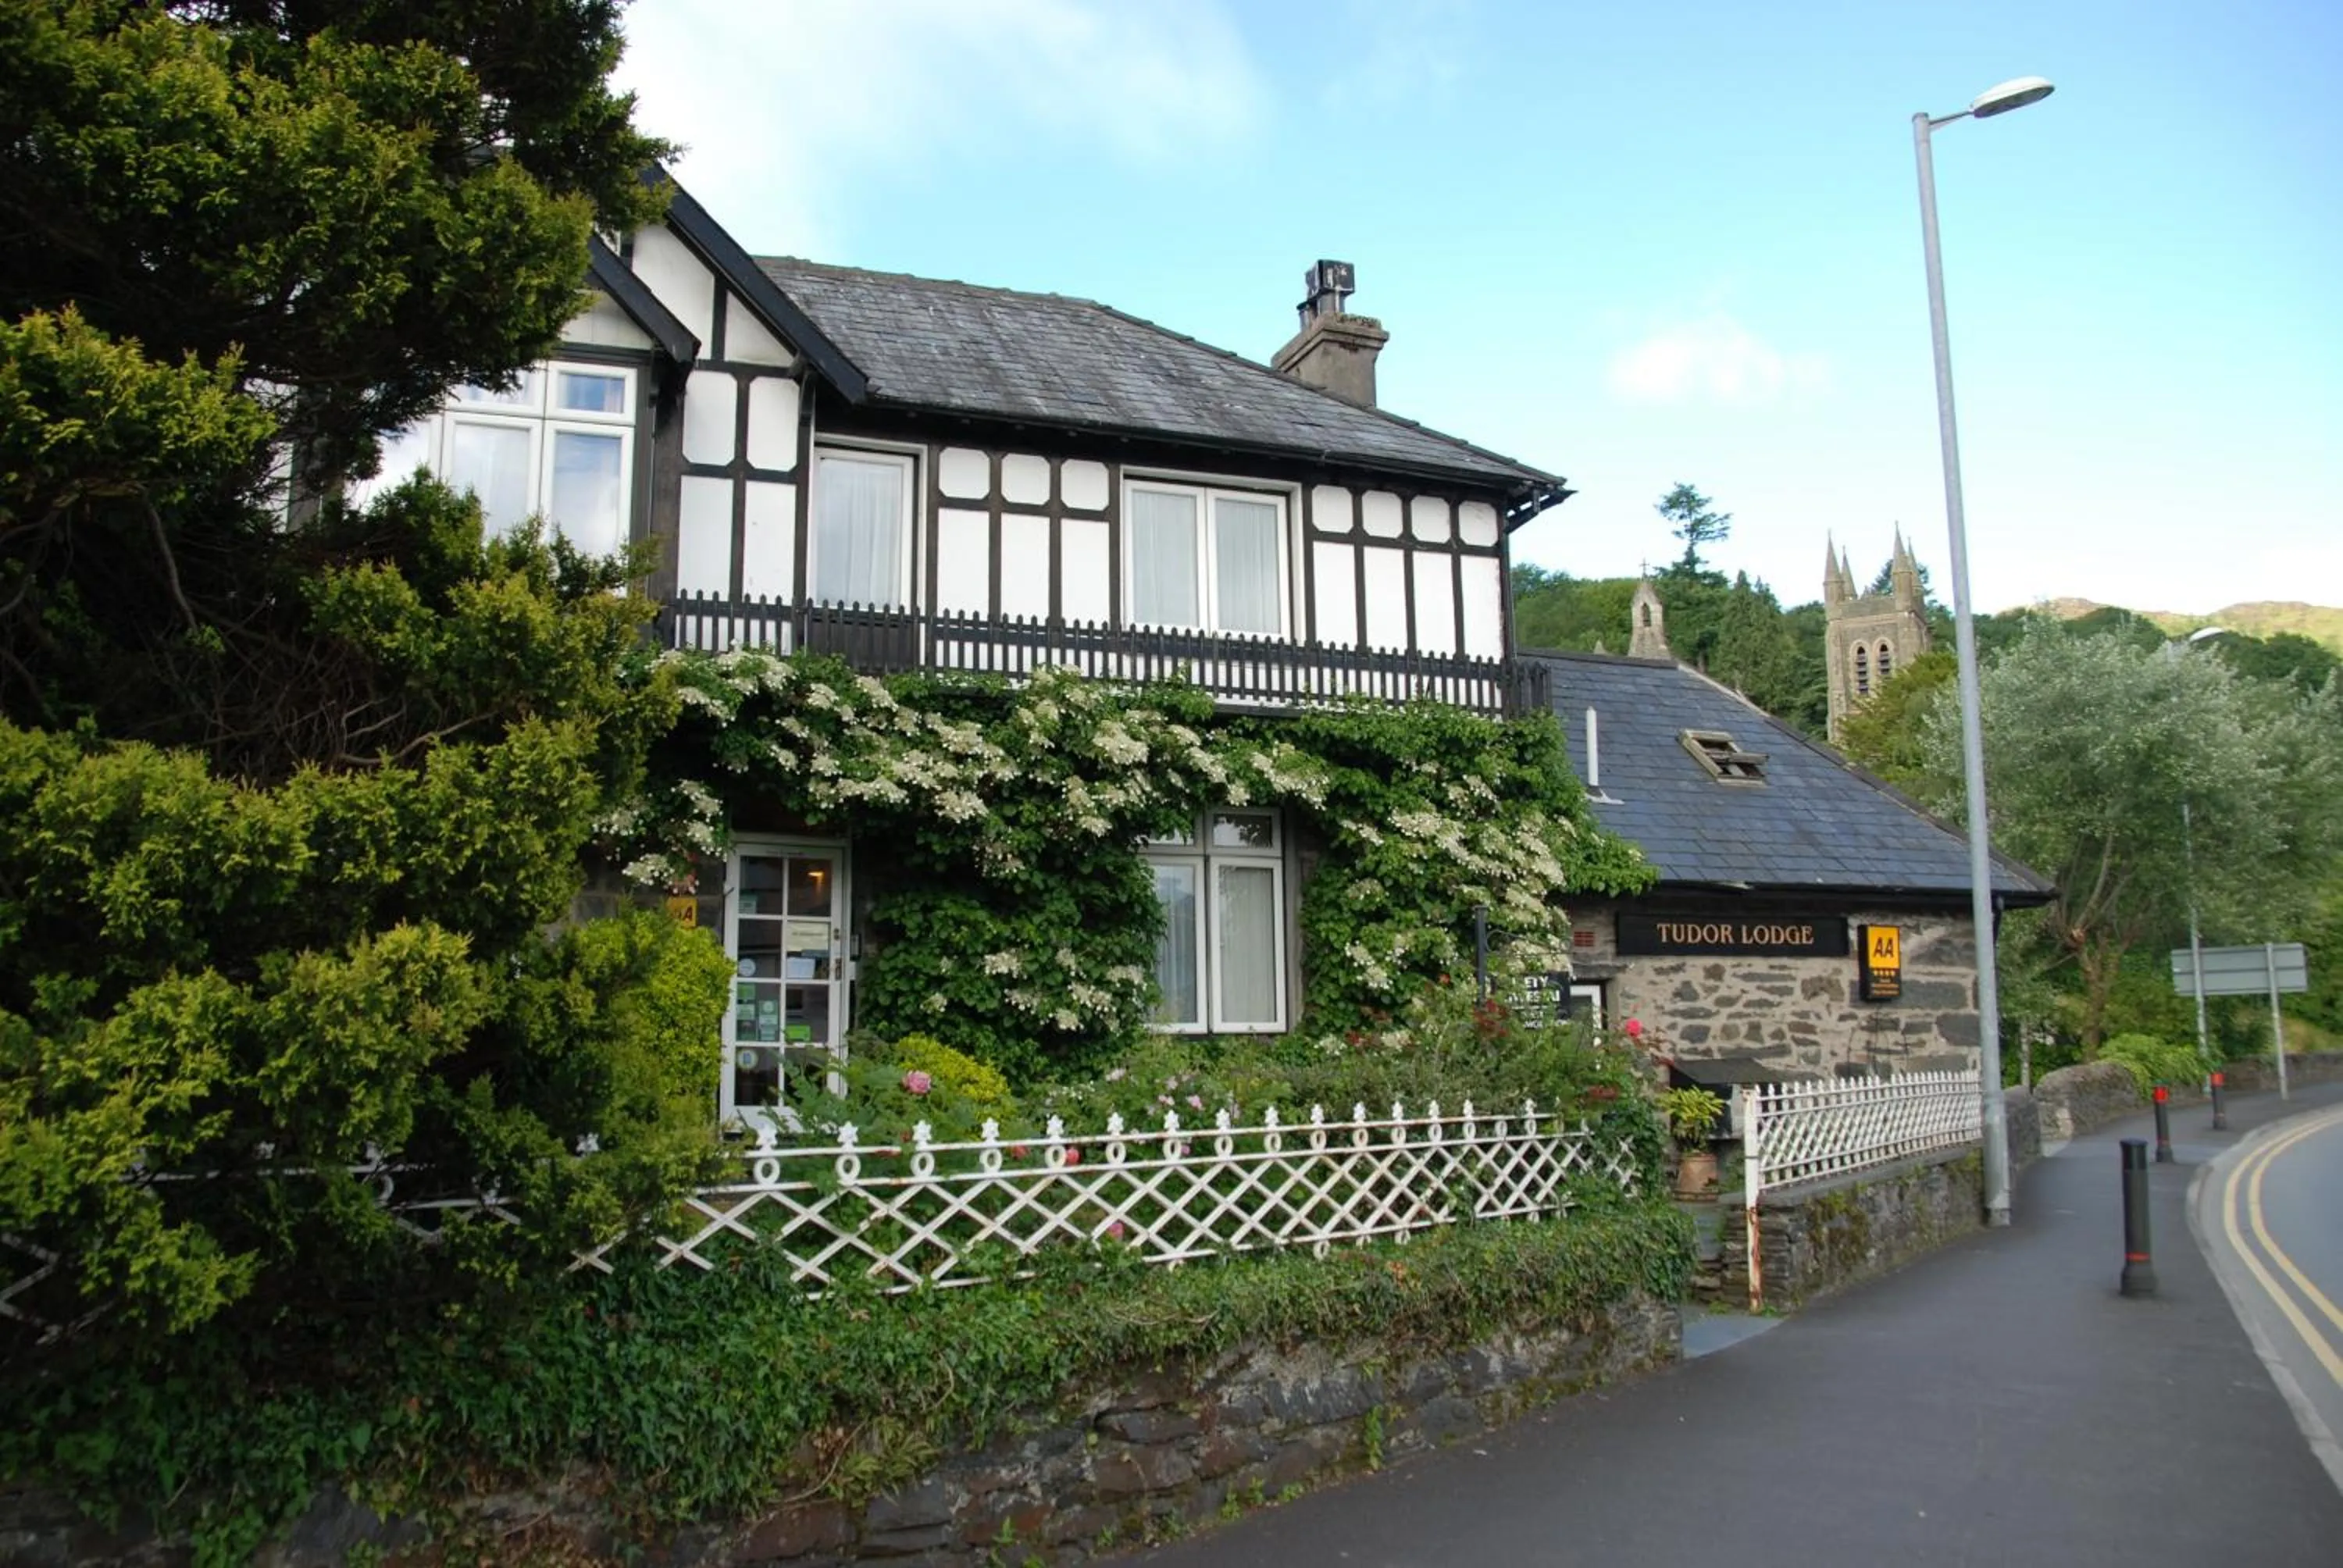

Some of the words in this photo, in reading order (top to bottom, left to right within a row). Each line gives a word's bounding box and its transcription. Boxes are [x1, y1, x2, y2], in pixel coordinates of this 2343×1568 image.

[1657, 923, 1734, 944] TUDOR
[1741, 924, 1814, 945] LODGE
[1873, 936, 1894, 958] AA
